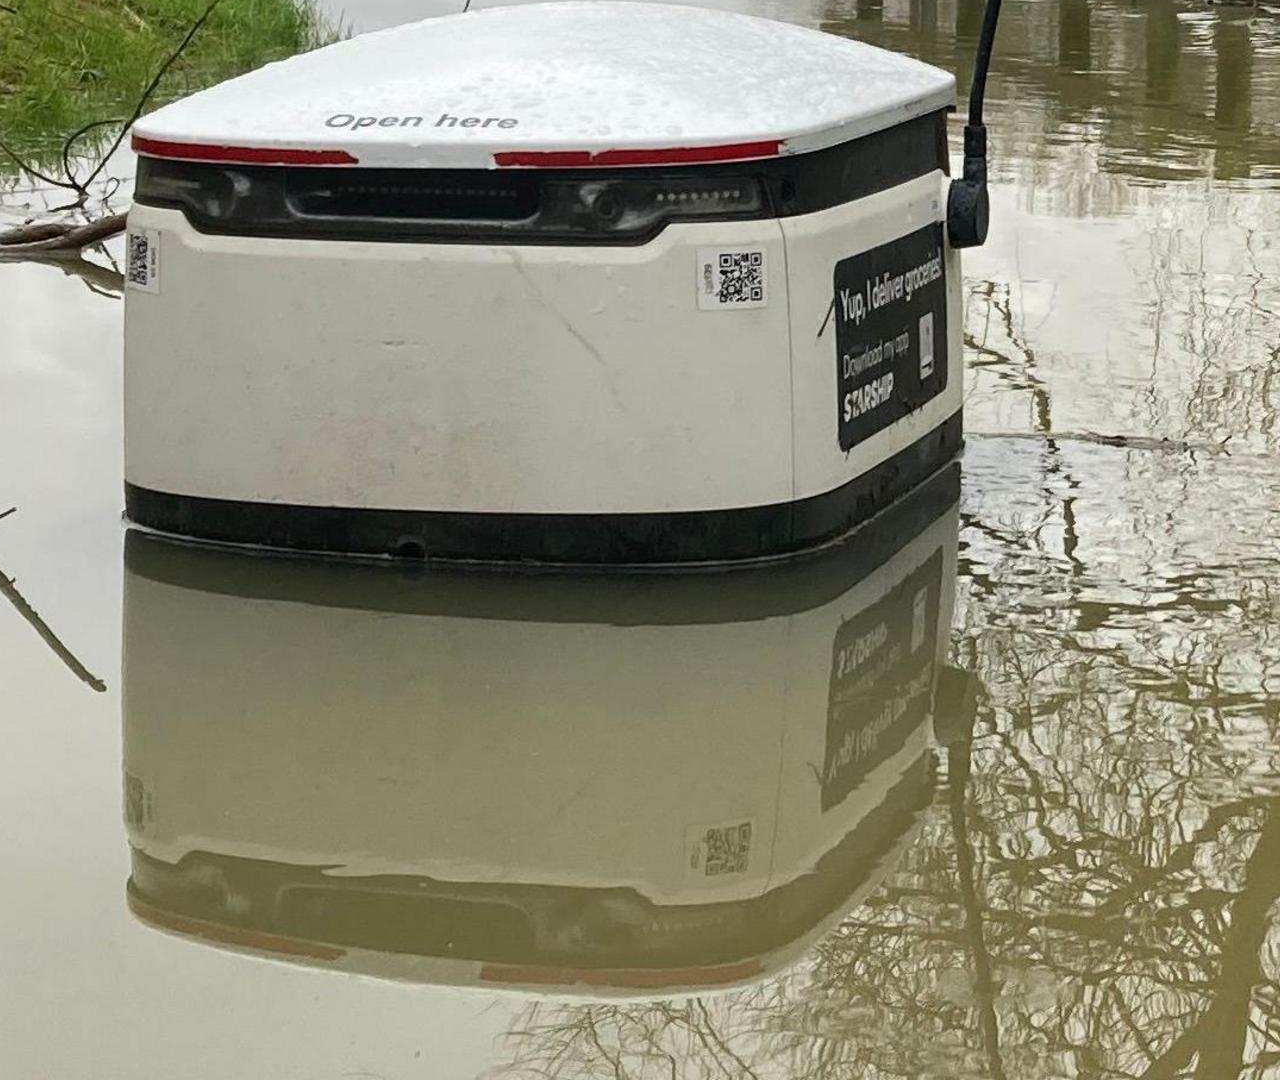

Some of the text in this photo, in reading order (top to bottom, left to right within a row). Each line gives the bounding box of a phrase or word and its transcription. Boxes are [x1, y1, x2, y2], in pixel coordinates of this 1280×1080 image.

[324, 113, 519, 131] Open here
[840, 287, 866, 326] Yup,
[866, 279, 872, 311] I
[872, 271, 904, 309] deliver
[843, 371, 894, 423] STARSHIP
